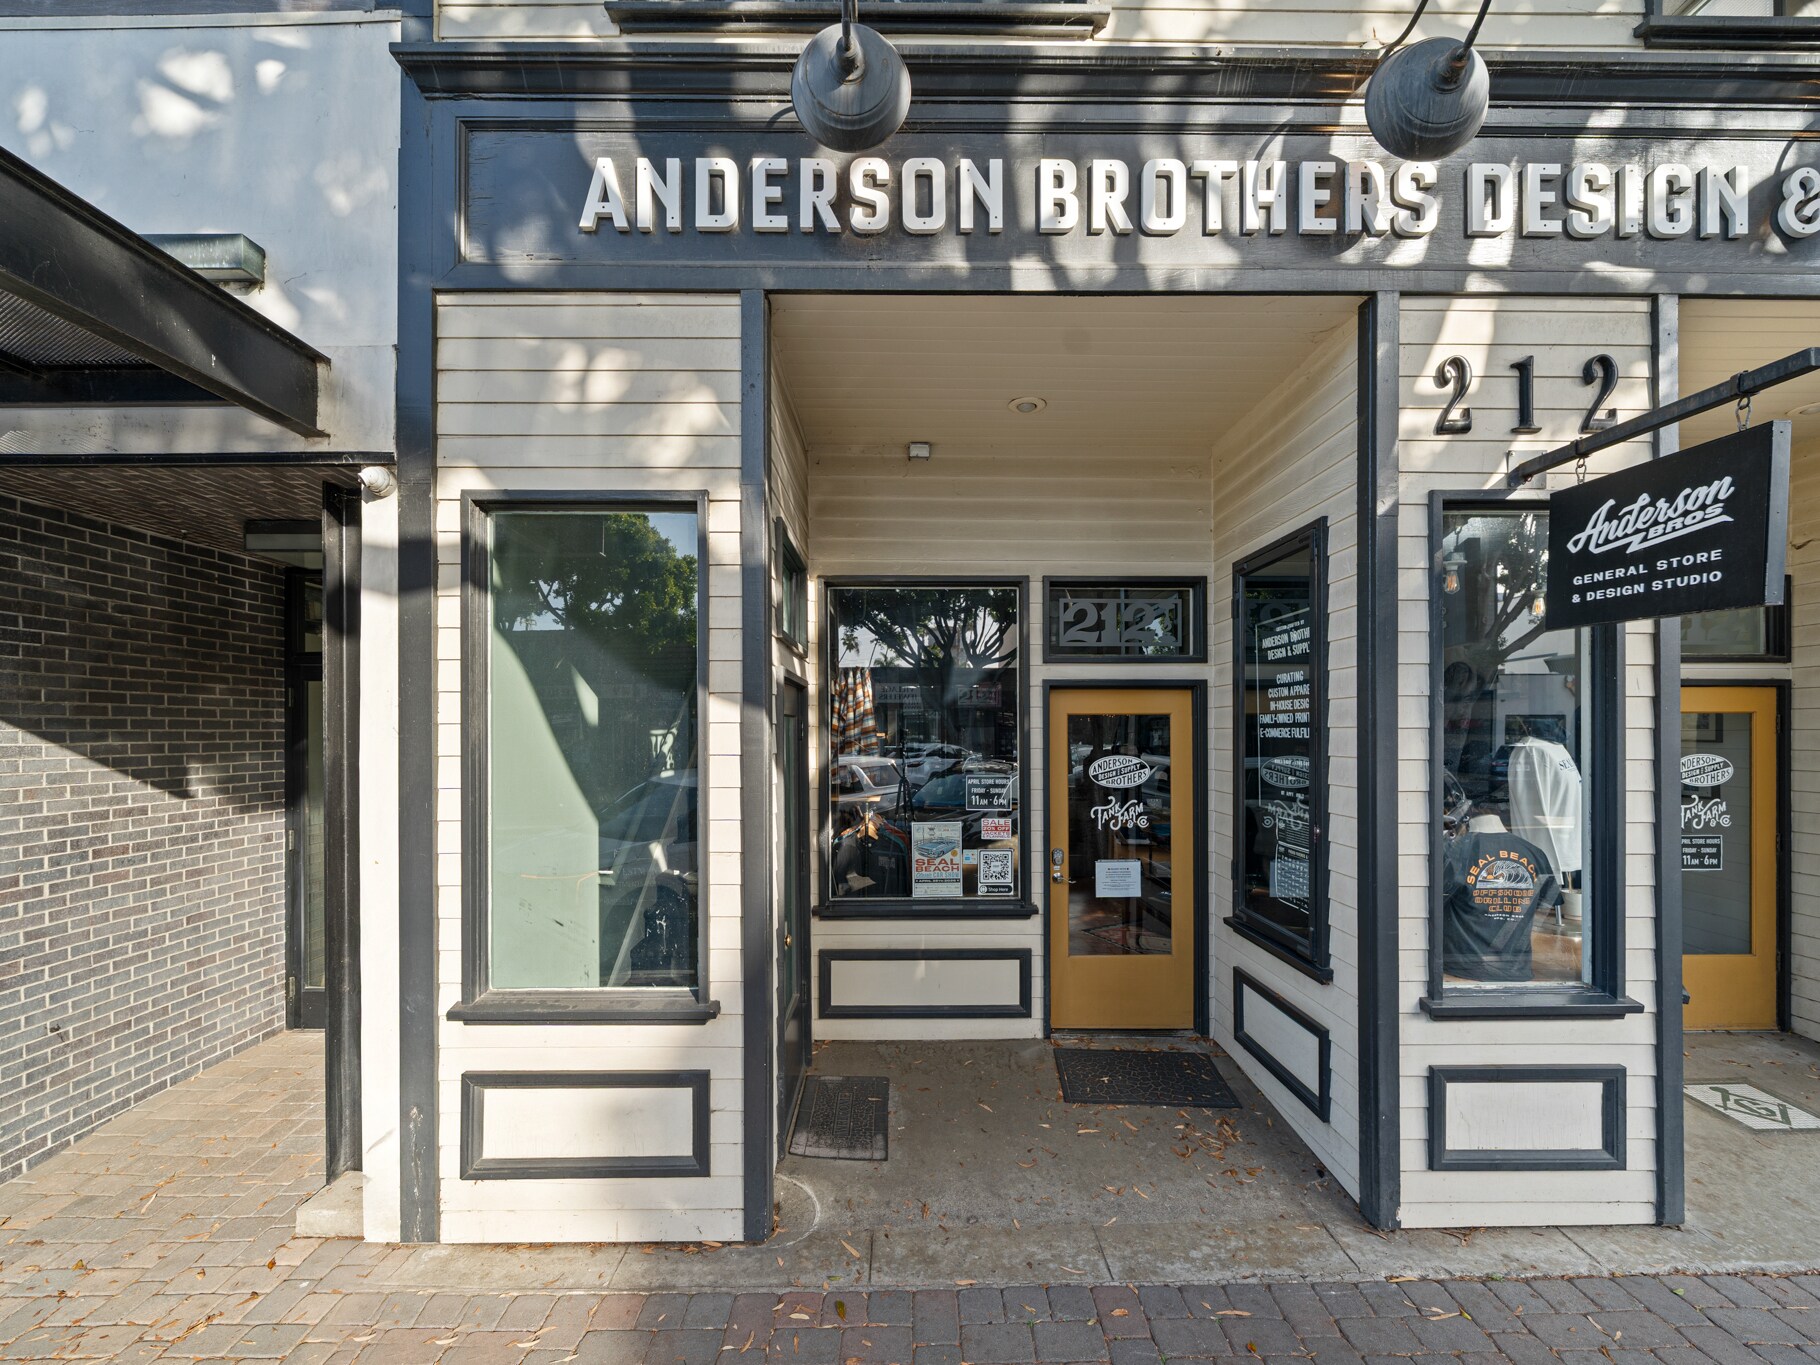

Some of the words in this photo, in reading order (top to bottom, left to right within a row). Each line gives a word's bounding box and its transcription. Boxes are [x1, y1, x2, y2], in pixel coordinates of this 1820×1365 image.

[578, 157, 1004, 235] ANDERSON
[1039, 158, 1438, 237] BROTHERS
[1466, 162, 1749, 239] DESIGN
[1778, 167, 1820, 238] &
[1433, 354, 1618, 434] 212
[1567, 476, 1735, 554] Anderson
[1647, 503, 1725, 539] BROS
[1573, 564, 1649, 585] GENERAL
[1656, 549, 1723, 571] STORE
[1572, 594, 1581, 603] &
[1586, 583, 1645, 602] DESIGN
[1651, 571, 1722, 591] STUDIO
[1262, 633, 1289, 649] ANDERSON
[1292, 641, 1310, 655] SUPPL
[1276, 671, 1304, 684] CURATING
[1267, 686, 1289, 698] CUSTOM
[1270, 700, 1293, 711] IN-HOUSE
[1092, 758, 1133, 774] ANDERSON
[1098, 770, 1116, 780] DESIGN
[1120, 763, 1140, 775] SUPPLY
[1681, 769, 1699, 779] DESIGN
[1704, 762, 1724, 773] SUPPLY
[1090, 796, 1121, 830] TANK
[1110, 800, 1144, 830] FARM
[1127, 820, 1133, 828] &
[1681, 794, 1704, 830] TANK
[1693, 799, 1726, 830] FARM
[1710, 818, 1717, 827] &
[915, 858, 960, 866] SEAL
[915, 865, 960, 873] BEACH
[1466, 853, 1495, 885] SEAL
